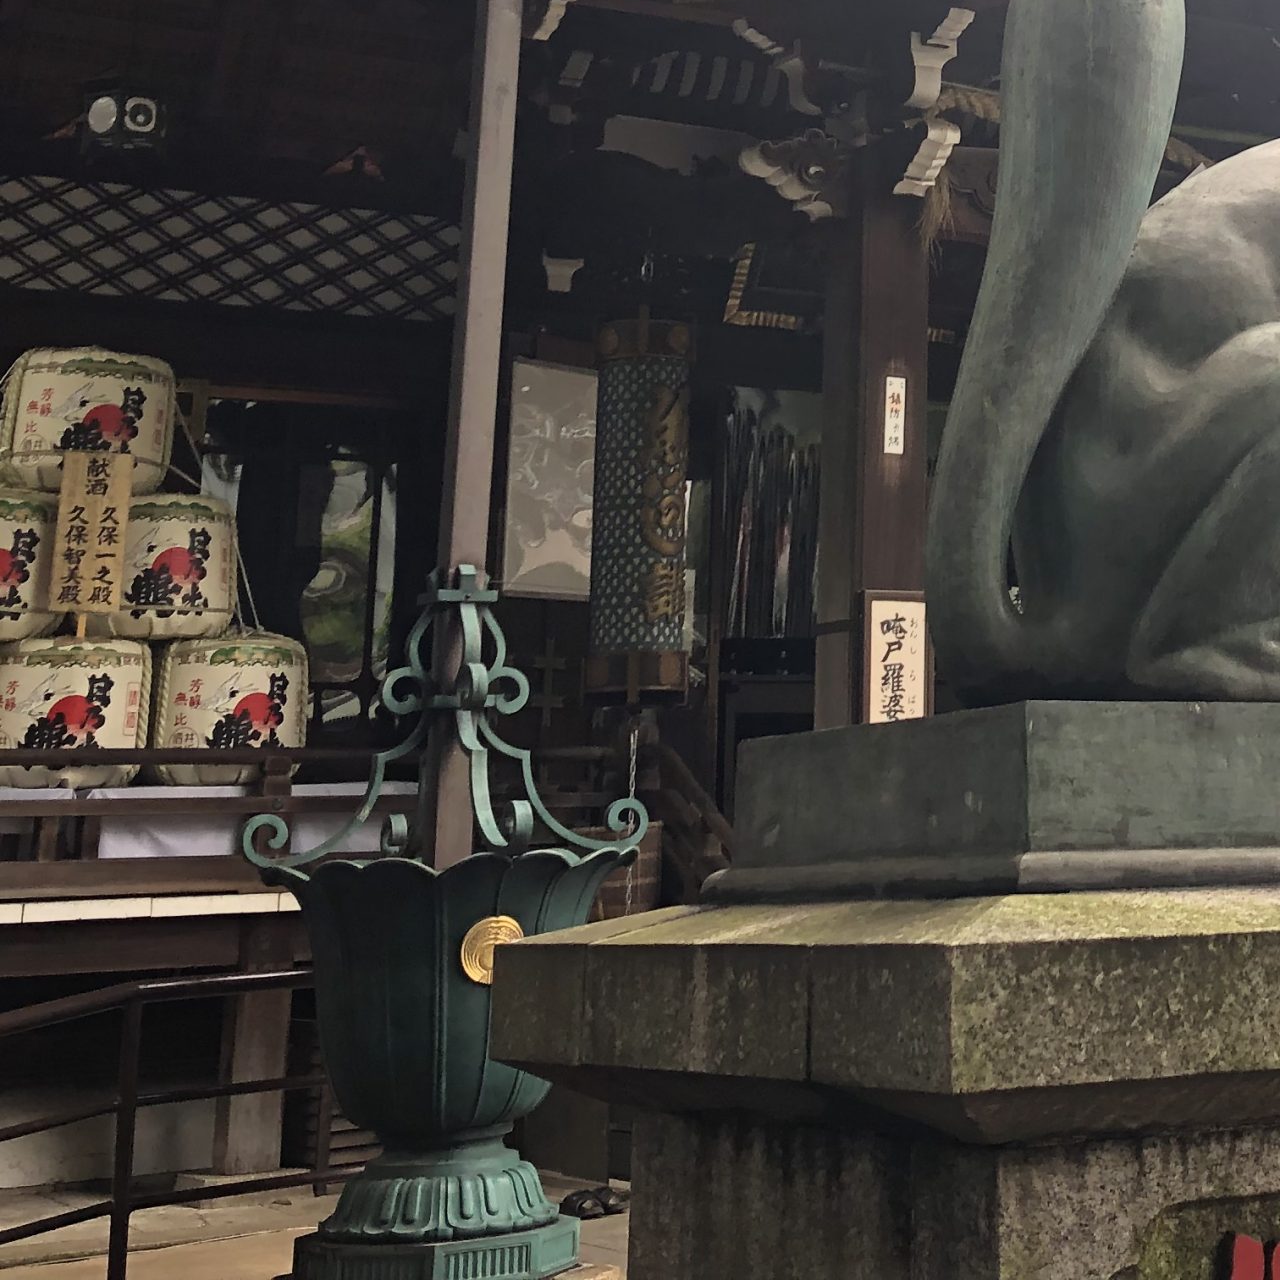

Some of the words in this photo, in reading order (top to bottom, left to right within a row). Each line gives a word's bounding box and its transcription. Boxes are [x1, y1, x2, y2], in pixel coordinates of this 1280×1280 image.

[86, 457, 111, 497] 献酒
[57, 506, 90, 605] 久保智美殿
[87, 506, 120, 605] 久保一之殿
